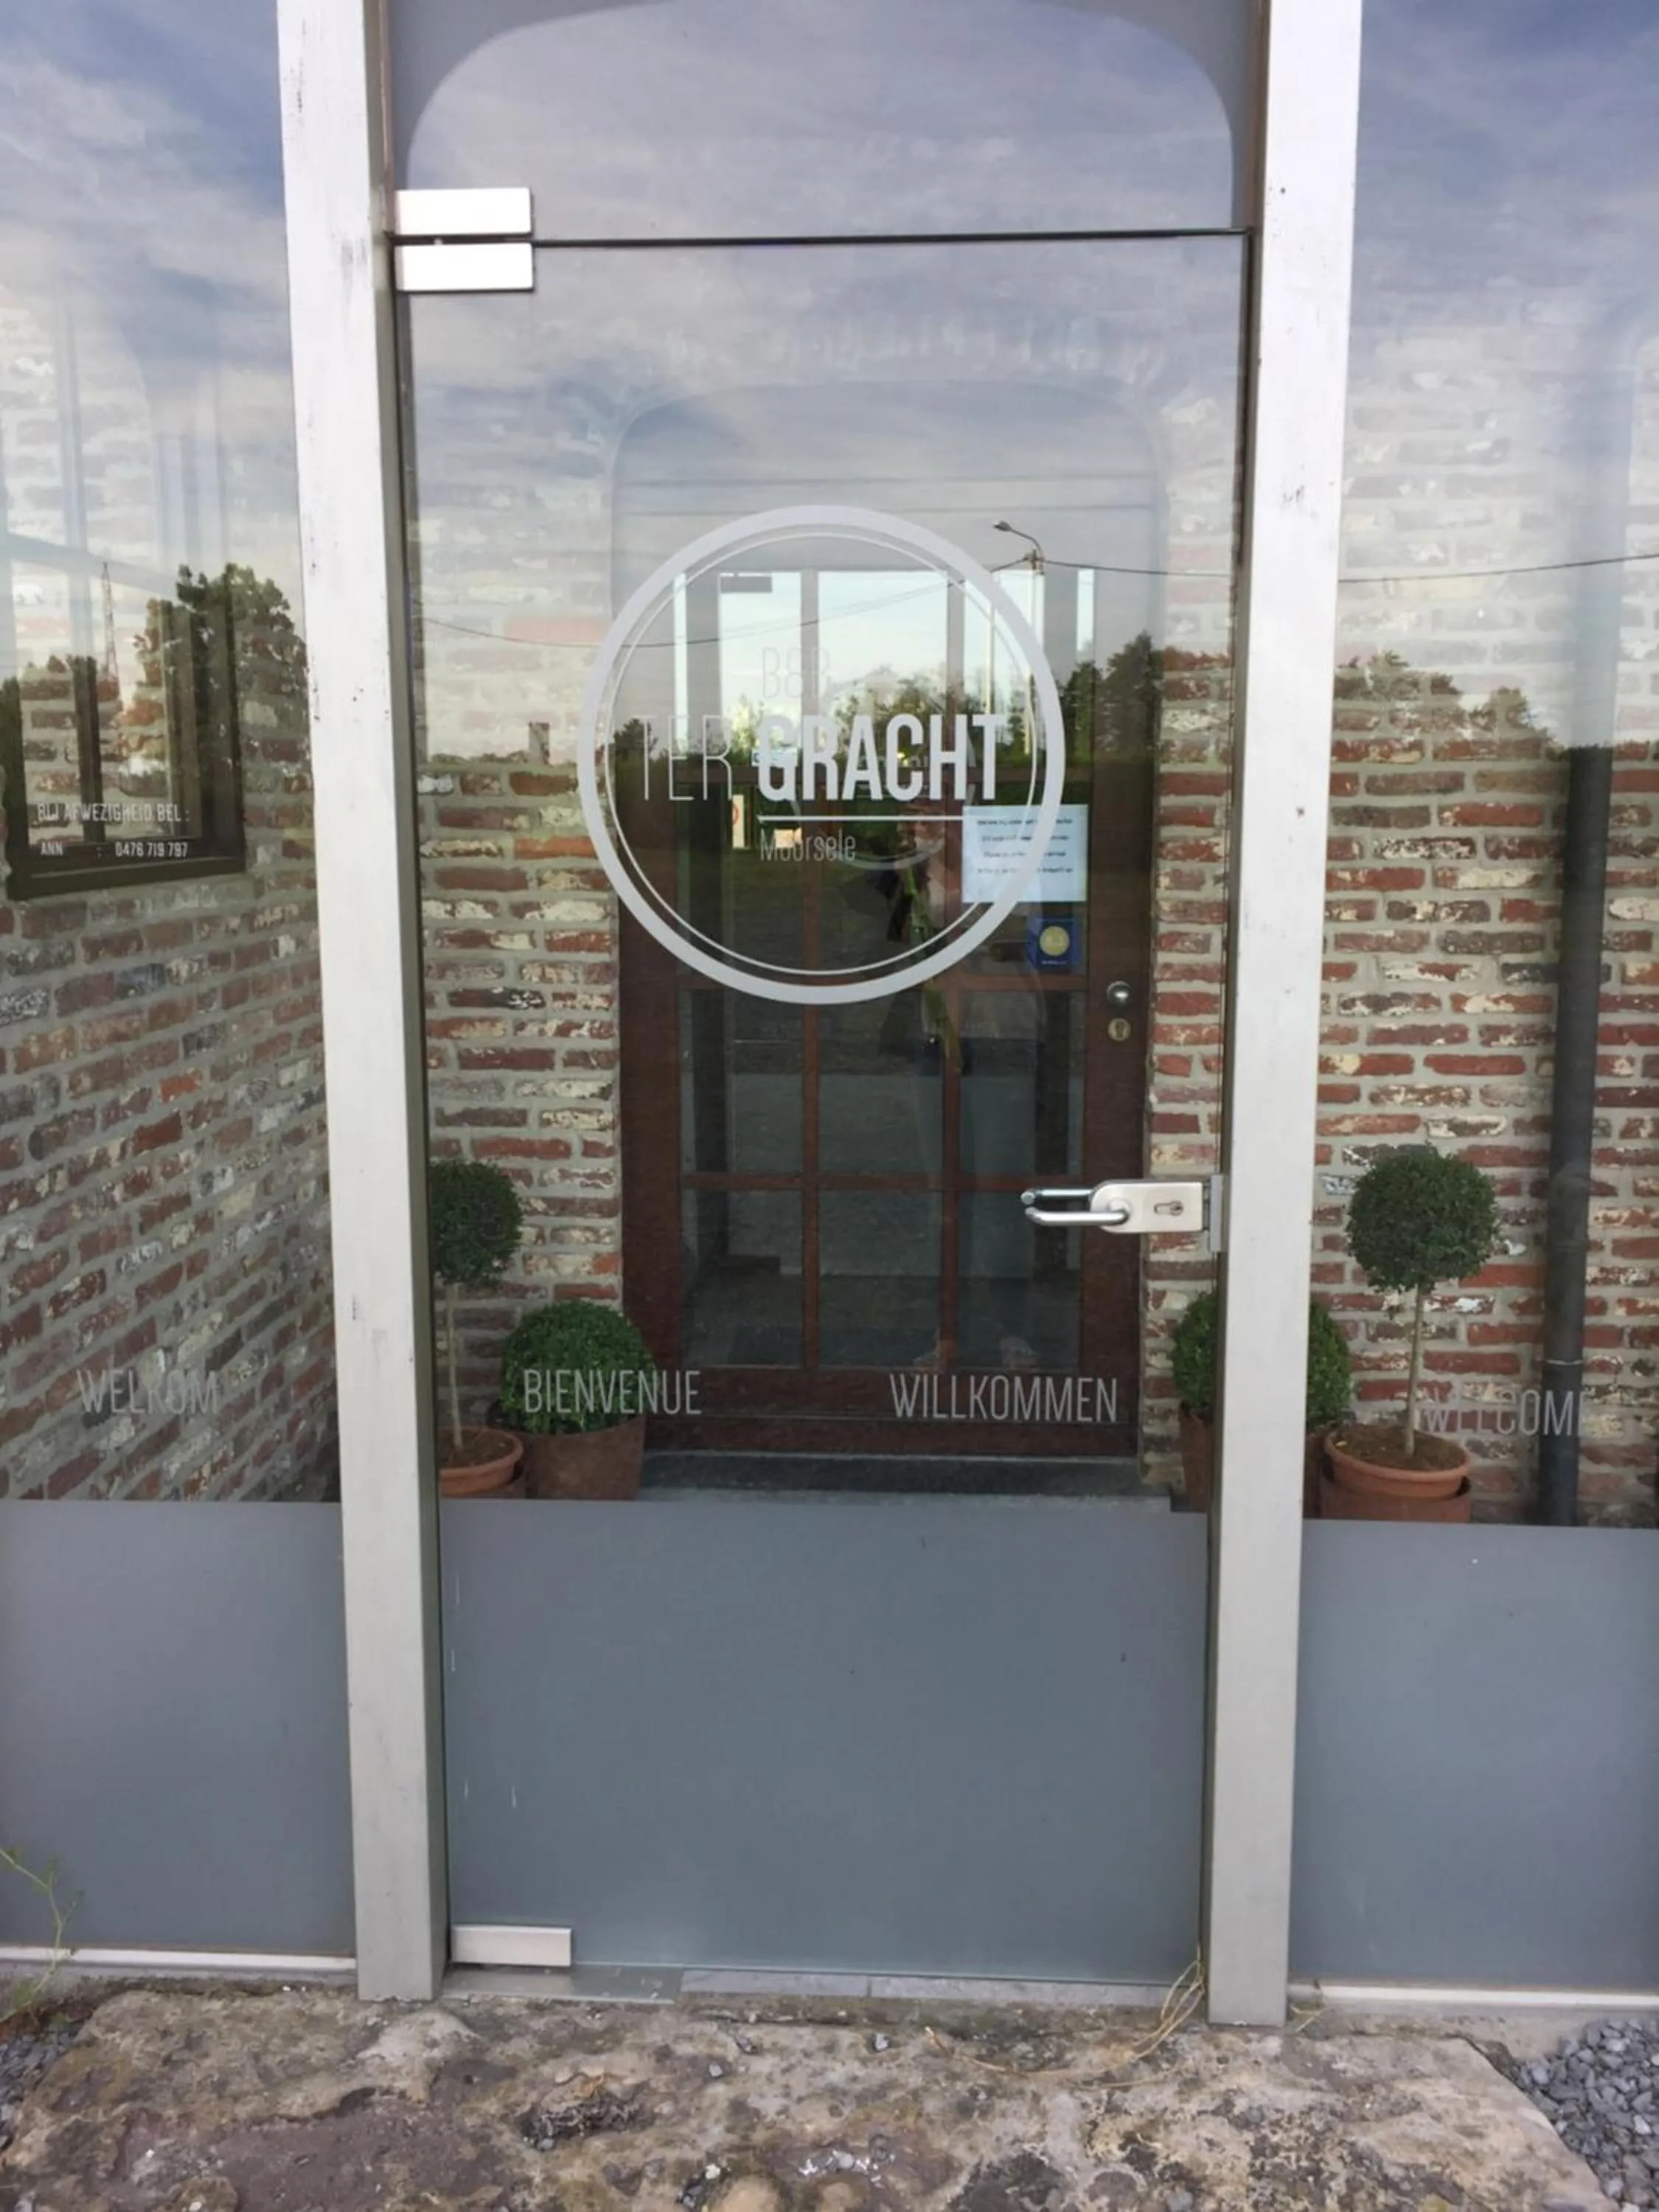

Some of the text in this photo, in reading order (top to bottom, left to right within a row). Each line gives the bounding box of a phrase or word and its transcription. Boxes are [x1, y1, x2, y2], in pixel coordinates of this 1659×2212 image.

[633, 714, 1008, 801] TER GRACHT
[157, 803, 181, 822] BEL
[759, 828, 856, 862] Moorsele
[77, 1369, 218, 1413] WELKOM
[524, 1368, 701, 1414] BIENVENUE
[889, 1374, 1117, 1422] WILLKOMMEN
